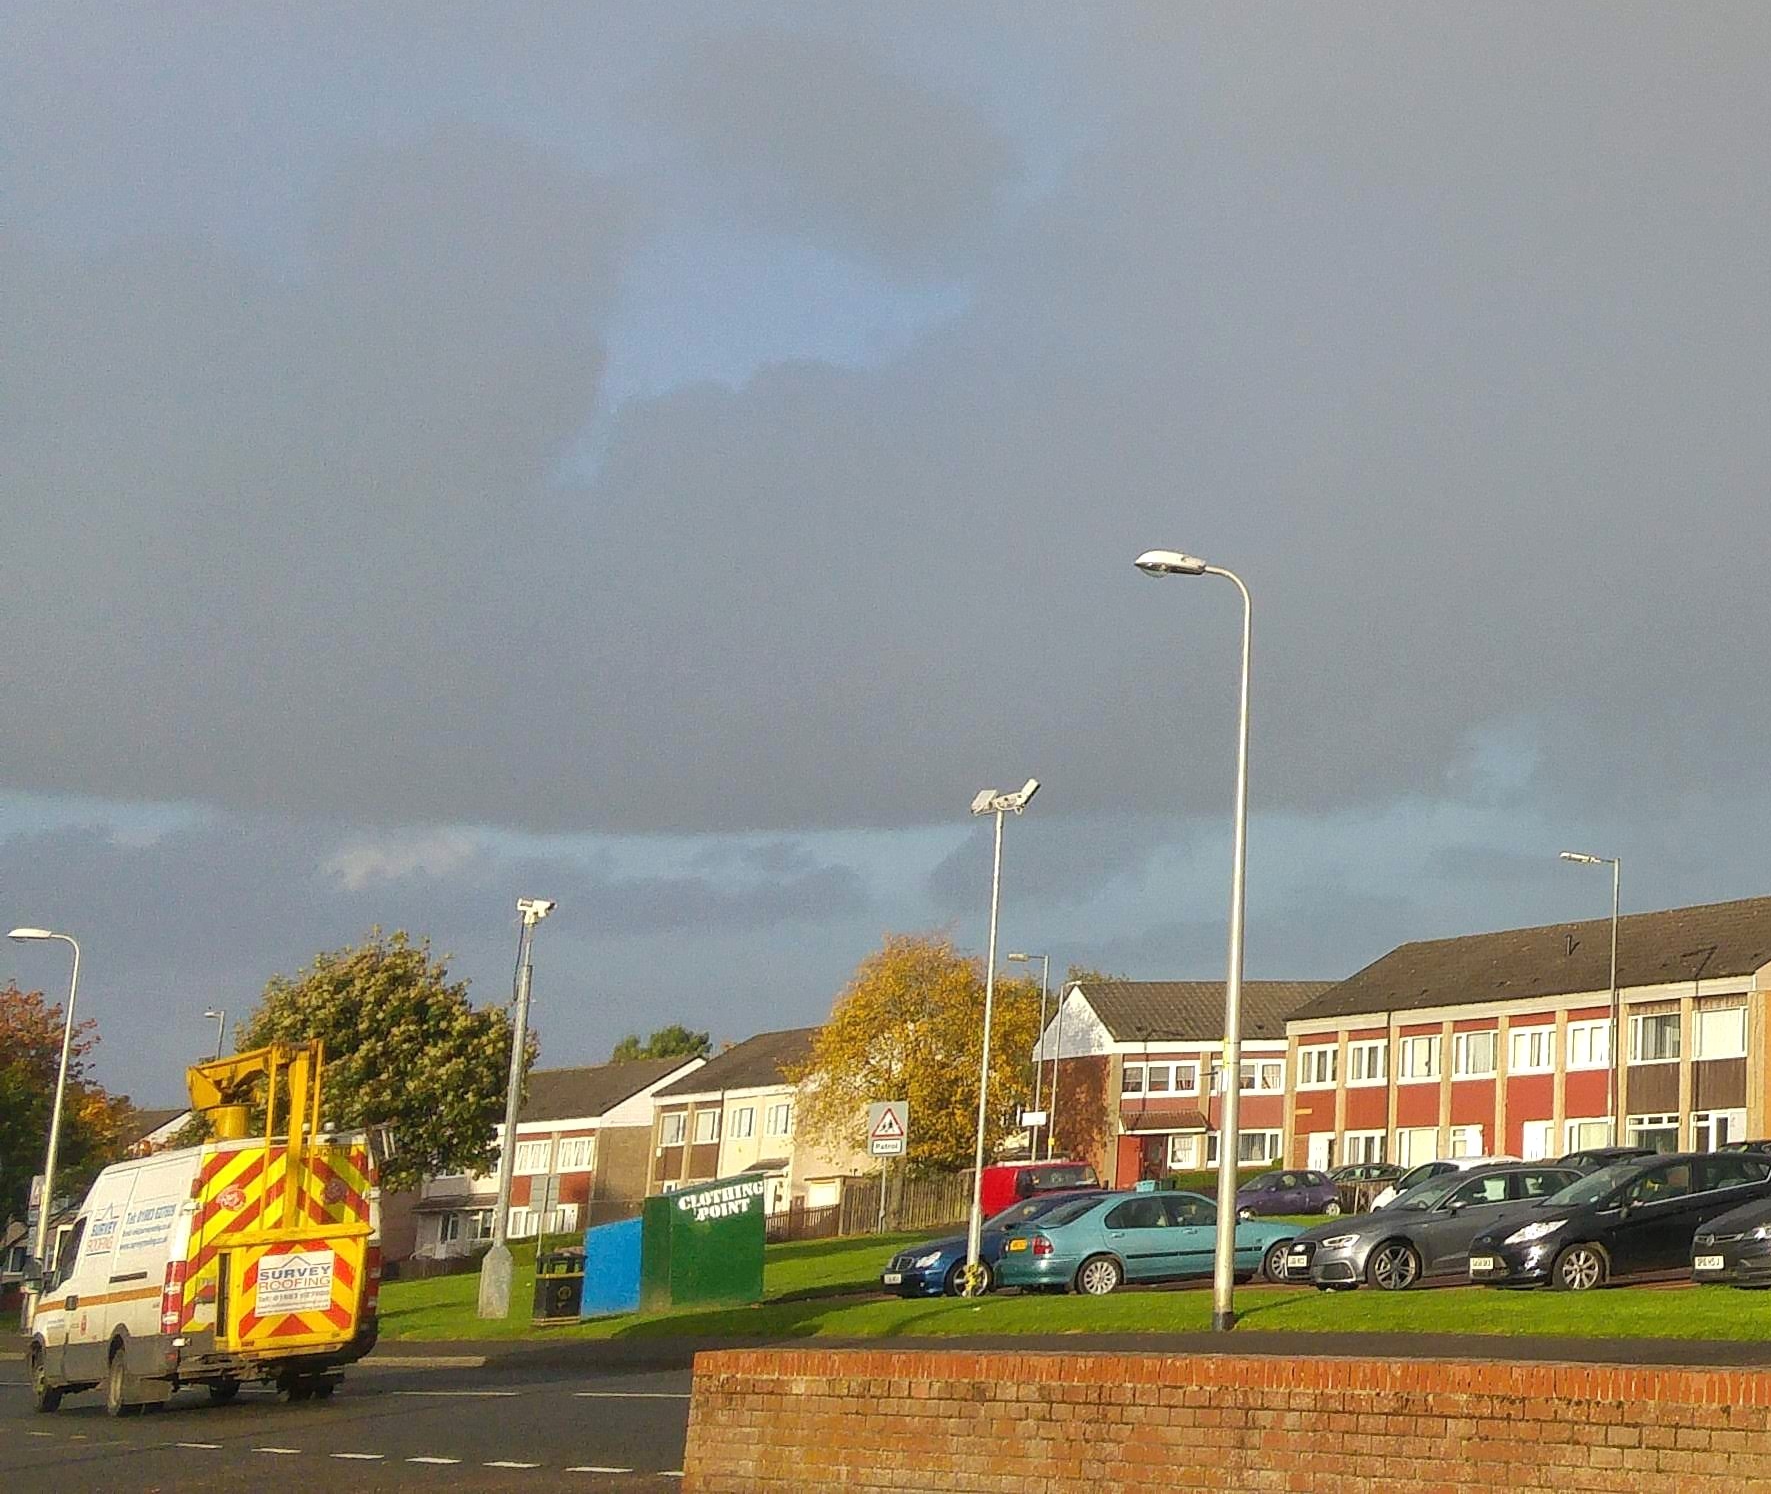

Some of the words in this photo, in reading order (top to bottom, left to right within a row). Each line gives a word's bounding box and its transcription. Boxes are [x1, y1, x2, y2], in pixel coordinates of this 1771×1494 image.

[678, 1181, 764, 1210] CLOTHING
[693, 1198, 751, 1221] POINT
[260, 1265, 331, 1281] SURVEY
[259, 1276, 331, 1291] ROOFING
